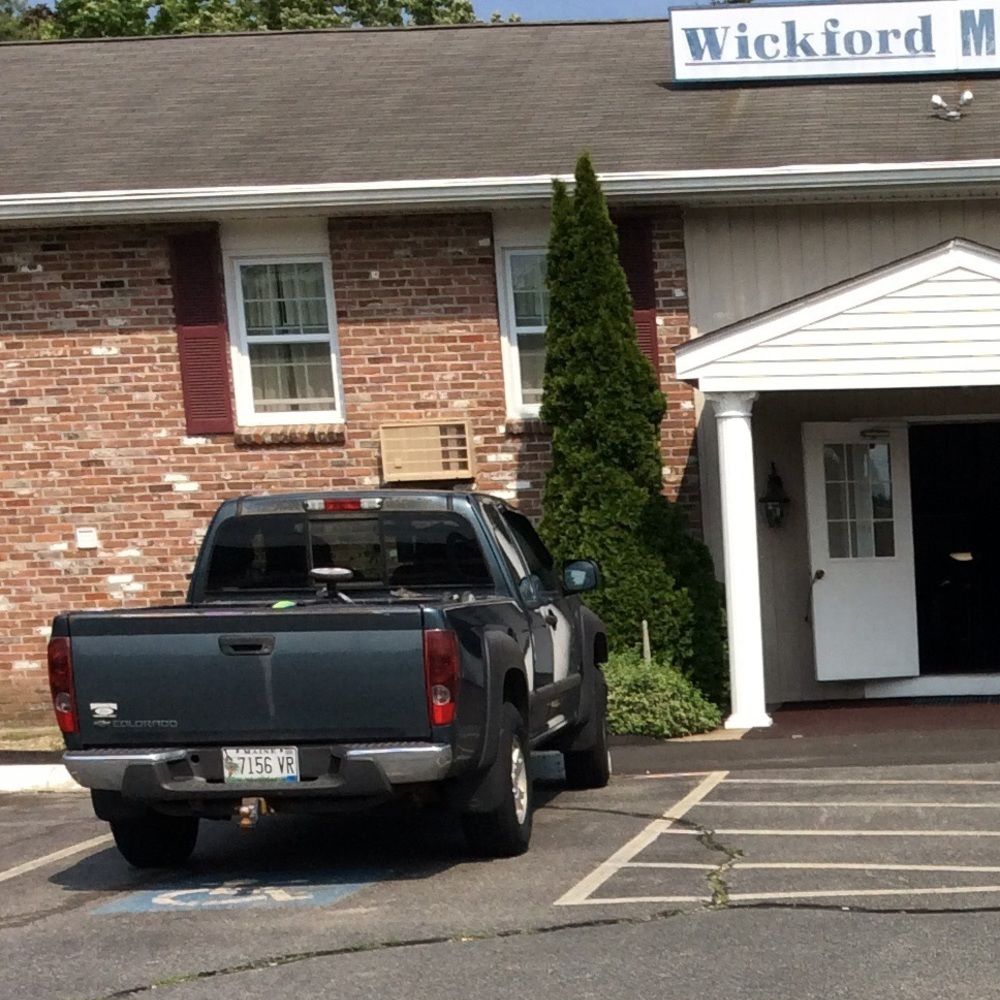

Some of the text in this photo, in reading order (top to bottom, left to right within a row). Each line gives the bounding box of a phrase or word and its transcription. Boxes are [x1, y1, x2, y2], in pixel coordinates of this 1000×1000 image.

[681, 14, 936, 61] Wickford
[112, 719, 178, 728] COLORADO
[237, 756, 295, 775] 7156 VR
